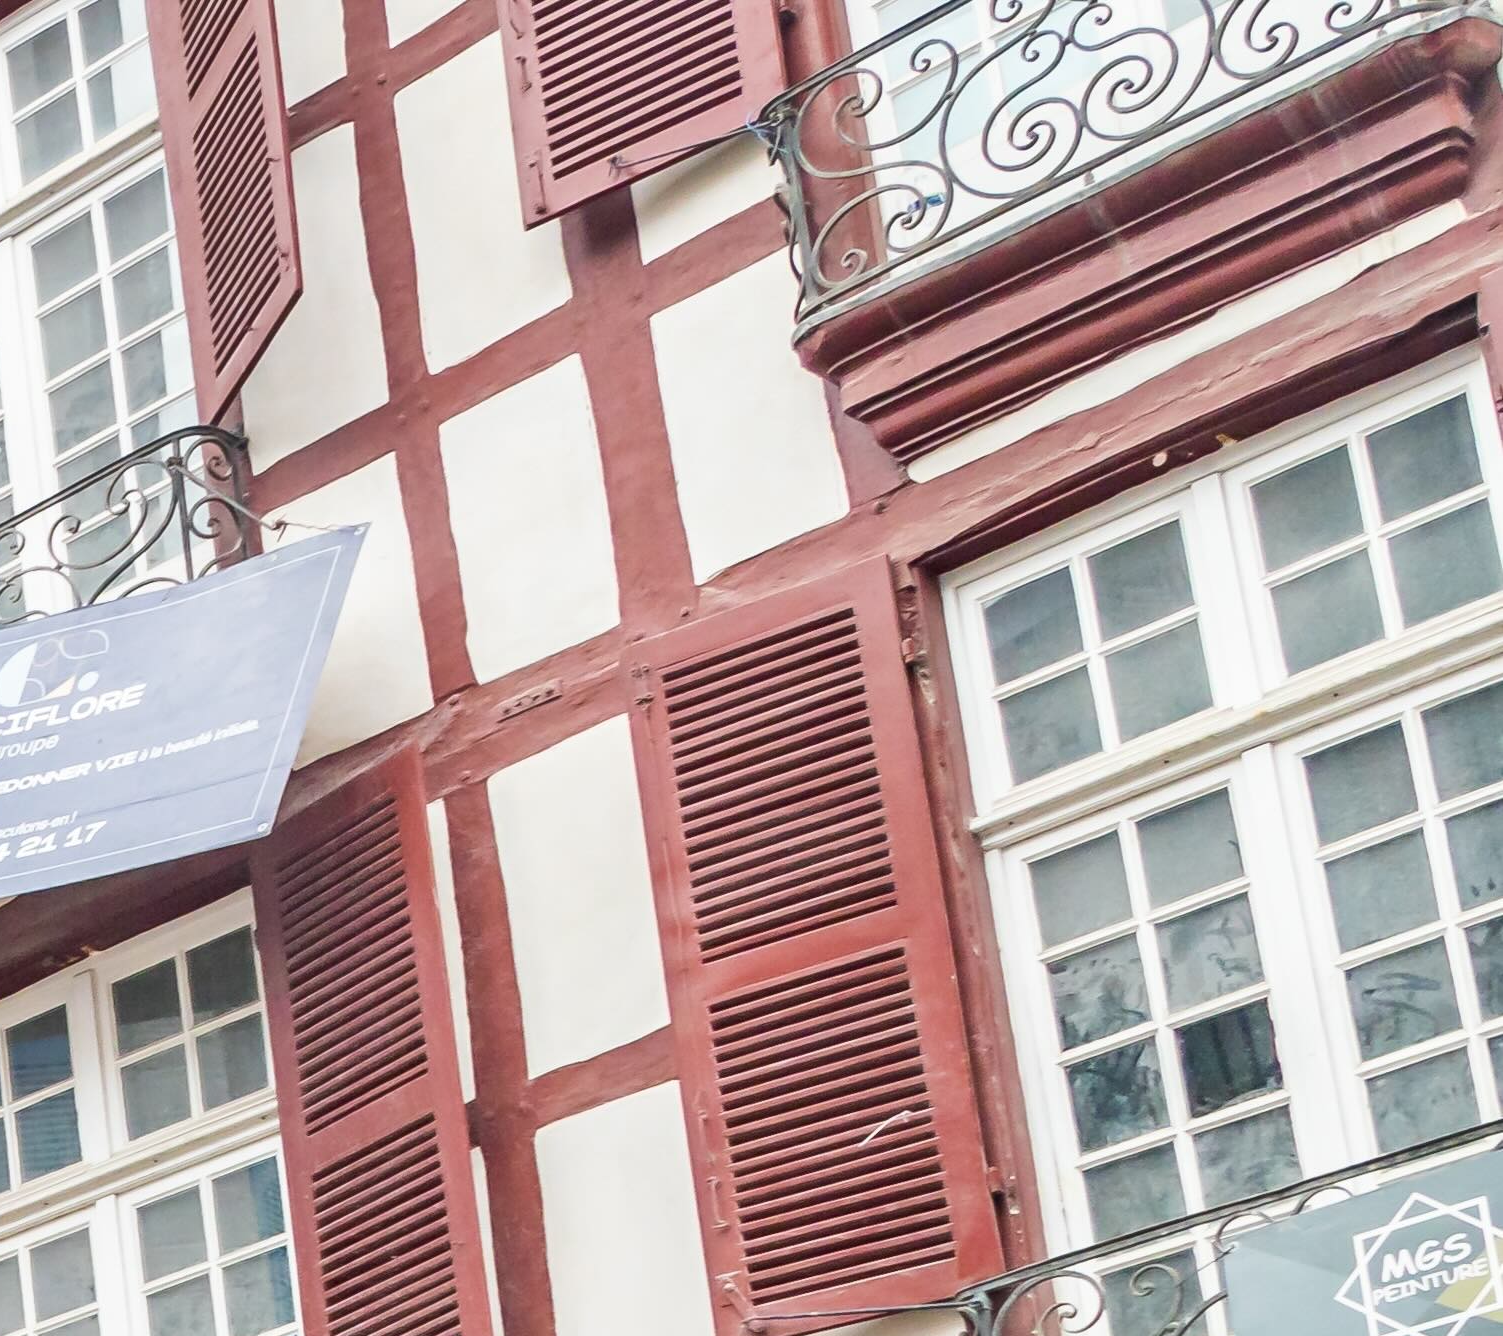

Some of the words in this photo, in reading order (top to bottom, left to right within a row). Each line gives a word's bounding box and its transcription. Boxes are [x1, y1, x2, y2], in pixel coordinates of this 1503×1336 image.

[95, 751, 139, 773] VIE
[163, 731, 213, 757] beauté
[15, 833, 60, 859] 21
[63, 820, 107, 850] 17
[1371, 1256, 1490, 1307] PEINTURE
[1380, 1232, 1473, 1285] MGS
